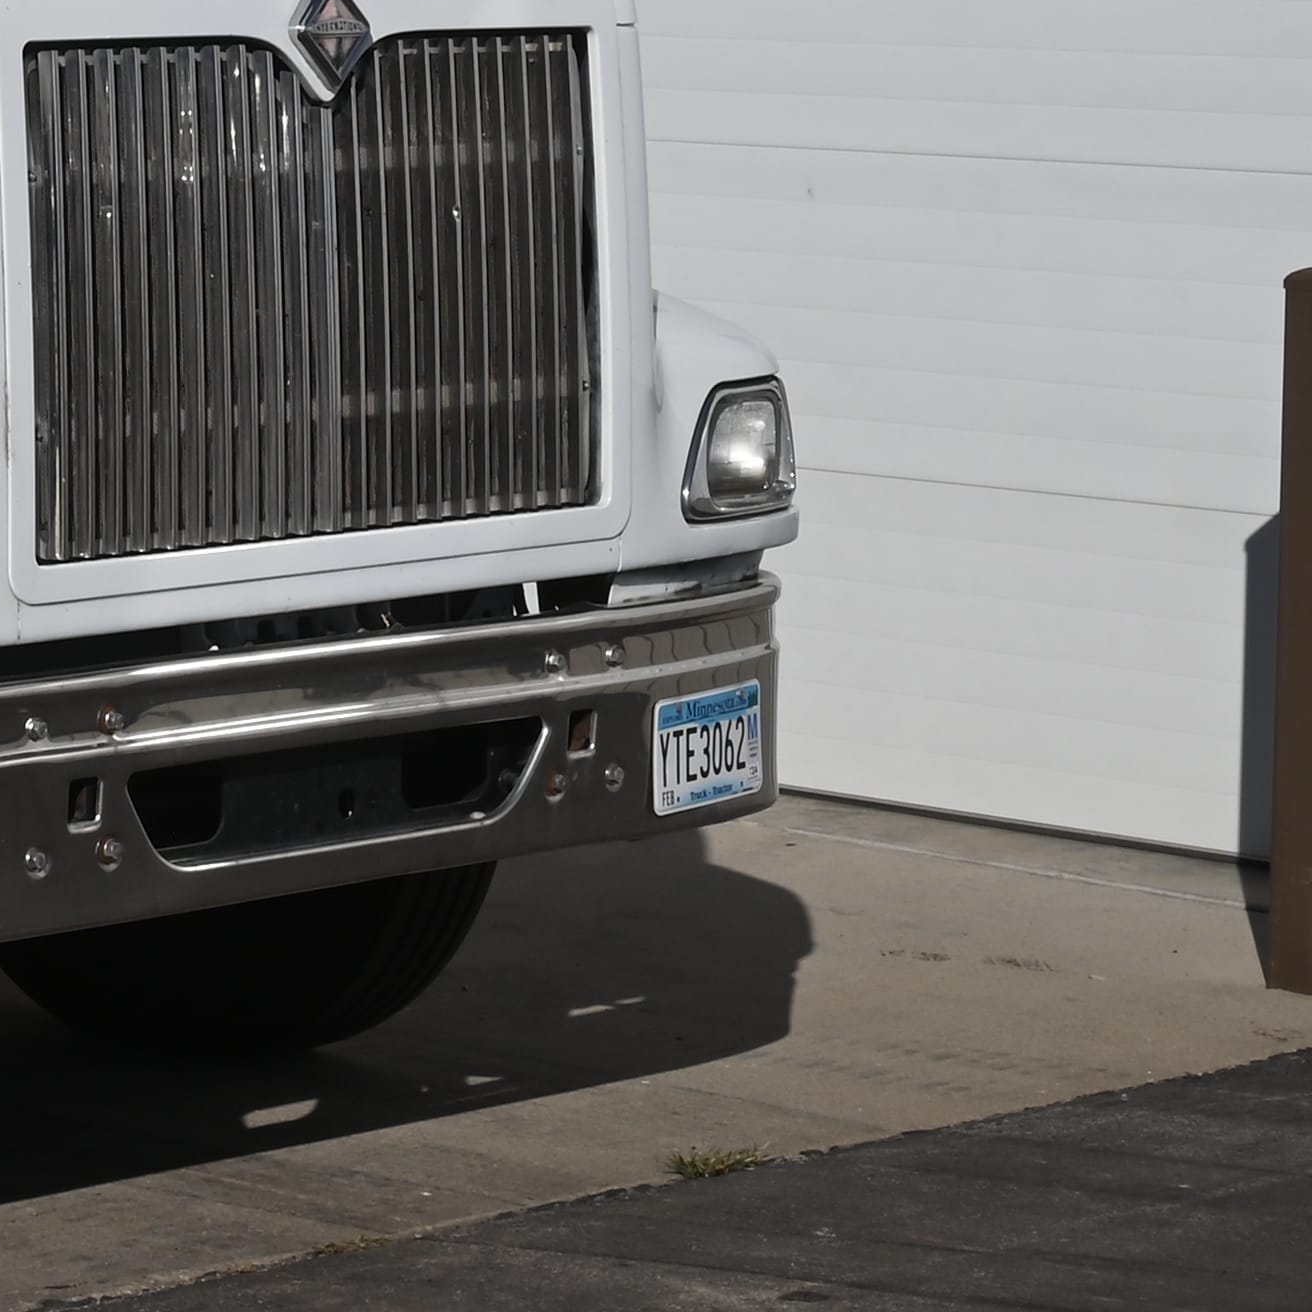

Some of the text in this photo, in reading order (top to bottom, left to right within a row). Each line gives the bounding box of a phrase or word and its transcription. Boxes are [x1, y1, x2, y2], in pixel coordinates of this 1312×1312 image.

[686, 698, 735, 720] Minnesota
[660, 716, 746, 788] YTE3062
[662, 790, 675, 807] FEB
[690, 789, 708, 802] Truck
